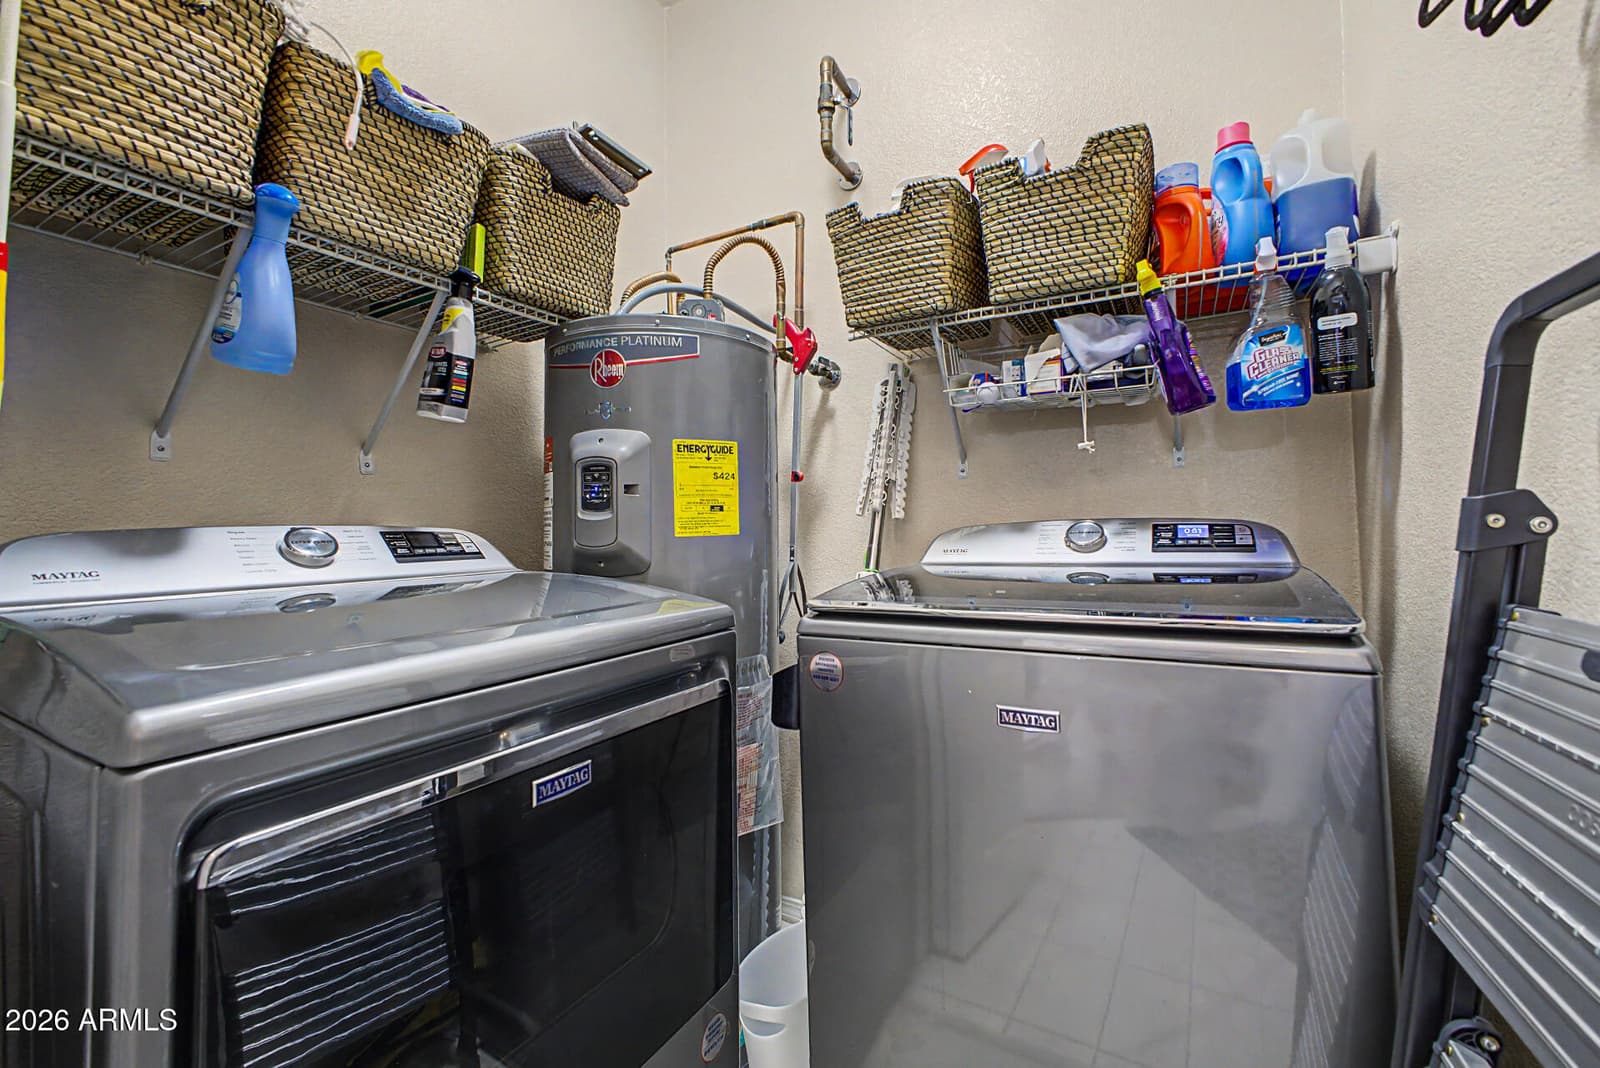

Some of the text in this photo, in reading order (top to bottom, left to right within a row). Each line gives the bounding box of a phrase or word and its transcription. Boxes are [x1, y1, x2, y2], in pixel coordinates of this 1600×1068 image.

[553, 335, 683, 357] PERFORMANCE PLATINUM
[594, 350, 624, 383] Rheem
[1247, 352, 1300, 379] CLEANER
[31, 570, 100, 581] MAYTAG
[1001, 711, 1056, 728] MAYTAG
[538, 768, 589, 799] MAYTAG
